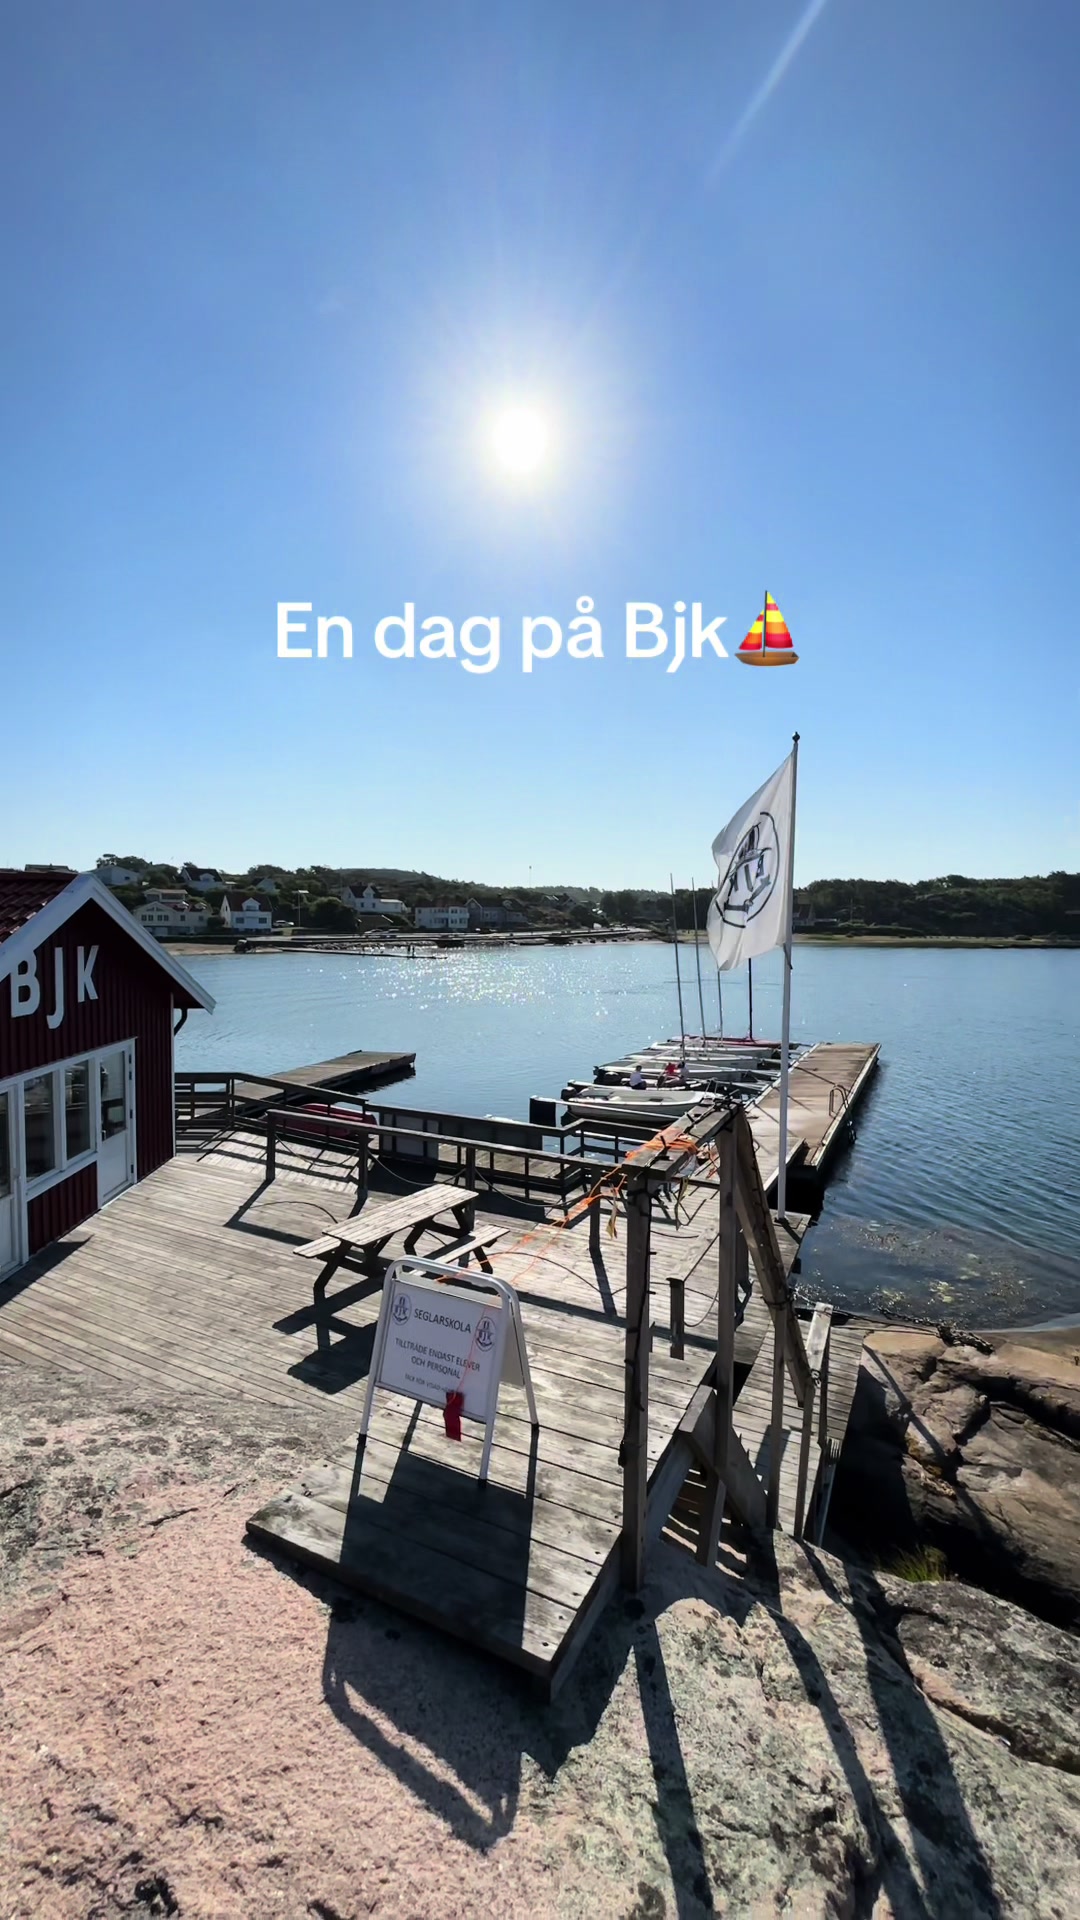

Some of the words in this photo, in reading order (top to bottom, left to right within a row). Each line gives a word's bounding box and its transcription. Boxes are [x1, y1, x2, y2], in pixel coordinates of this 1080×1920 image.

[10, 945, 99, 1030] BJK
[414, 1308, 471, 1334] SEGLARSKOLA
[411, 1356, 425, 1367] OCH
[427, 1360, 460, 1379] PERSONAL
[428, 1348, 455, 1363] ENDAST
[456, 1356, 480, 1372] ELEVER
